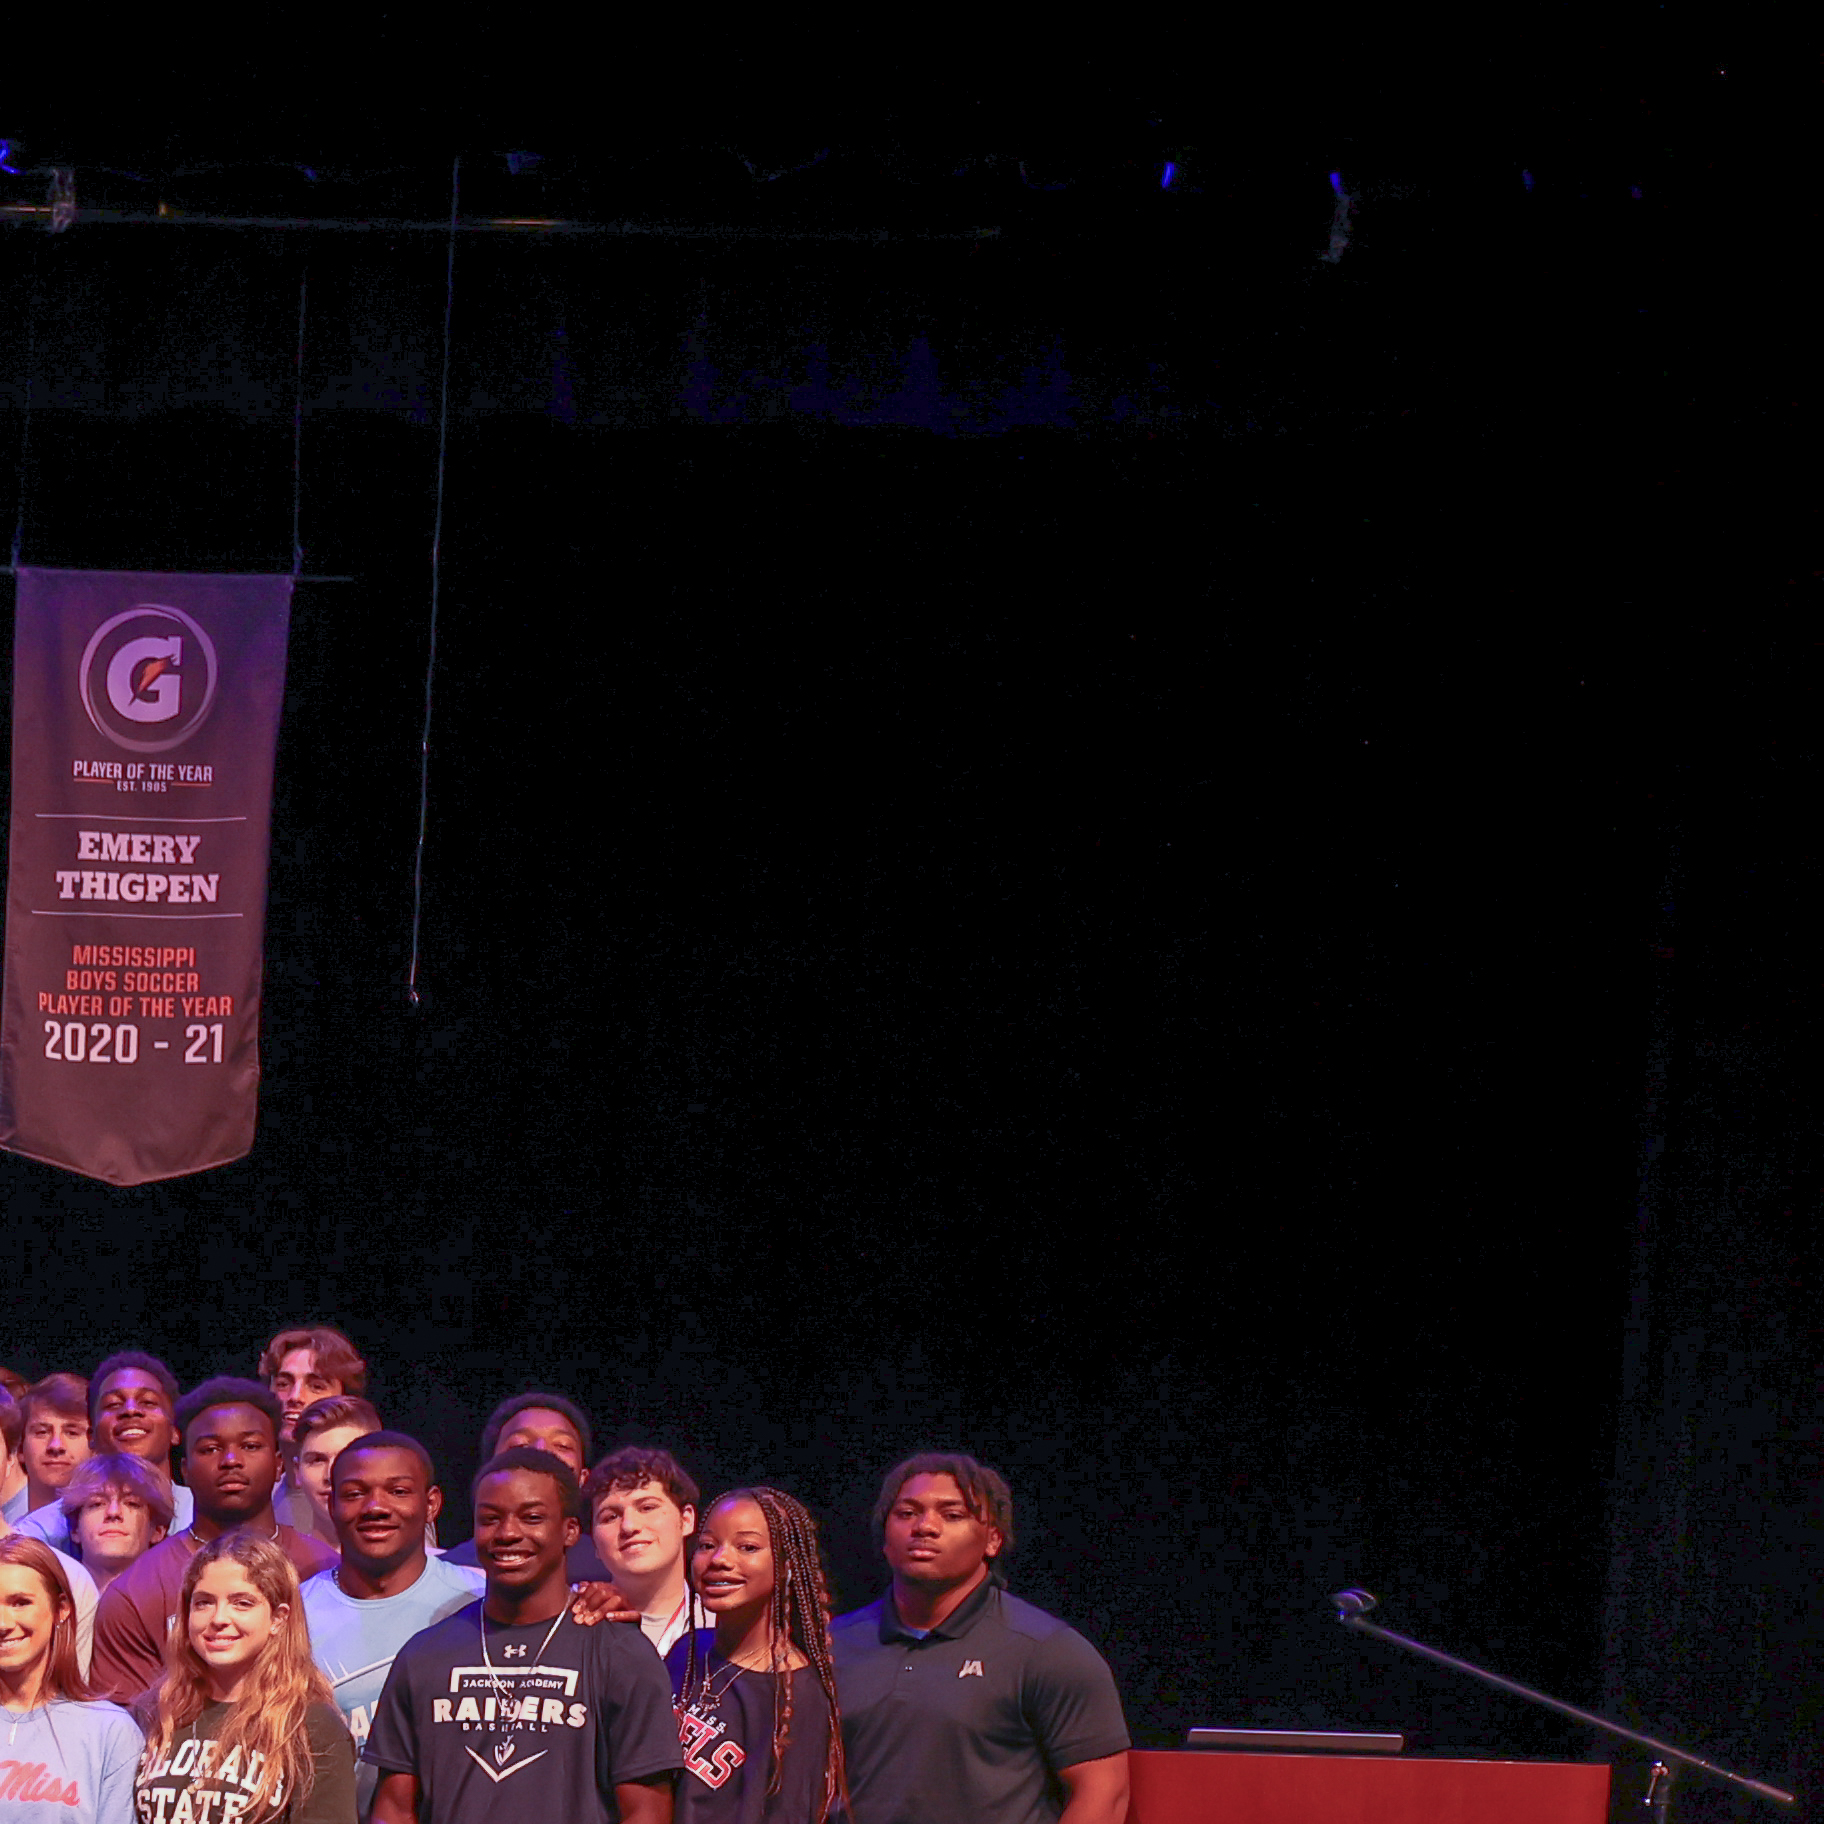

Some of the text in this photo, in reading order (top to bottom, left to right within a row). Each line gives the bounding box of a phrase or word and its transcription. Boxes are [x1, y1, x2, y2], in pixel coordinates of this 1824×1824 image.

[73, 760, 213, 782] PLAYER OF THE YEAR
[77, 831, 201, 865] EMERY
[56, 870, 219, 903] THIGPEN
[72, 945, 196, 968] MISSISSIPPI
[66, 970, 199, 993] BOYS SOCCER
[38, 992, 233, 1018] PLAYER OF THE YEAR
[44, 1021, 138, 1064] 2020
[184, 1023, 224, 1064] 21
[463, 1679, 515, 1689] JACKSON
